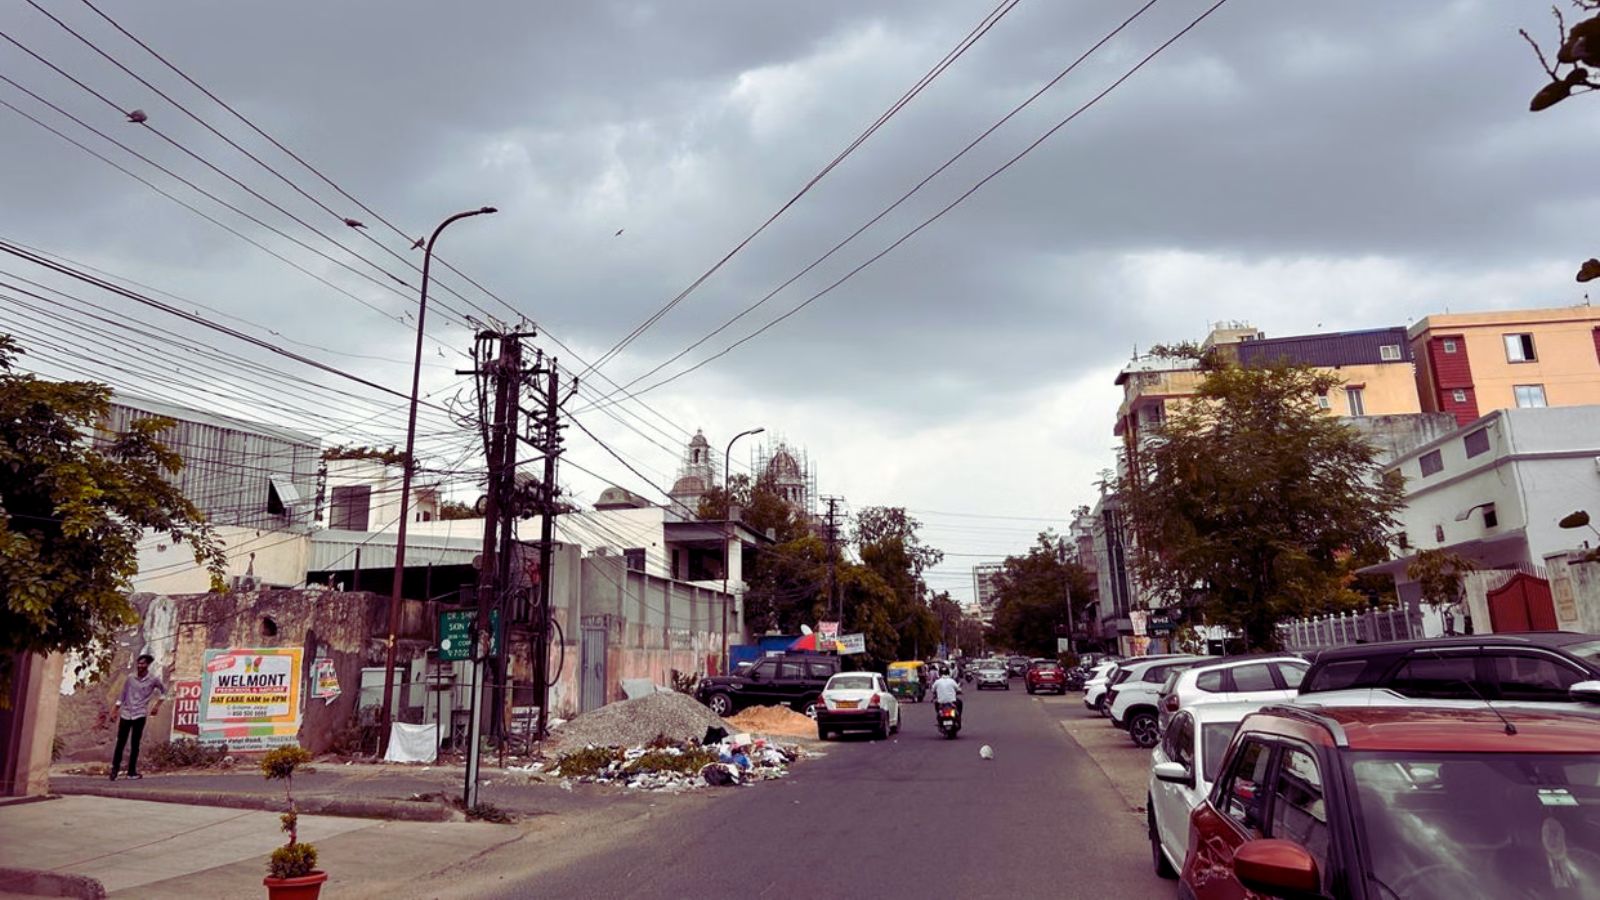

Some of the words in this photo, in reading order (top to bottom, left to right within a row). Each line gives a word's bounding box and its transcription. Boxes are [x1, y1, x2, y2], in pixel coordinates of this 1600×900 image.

[218, 673, 286, 687] WELMONT
[178, 685, 201, 698] PO
[210, 696, 224, 704] DAY
[225, 695, 245, 703] CARE
